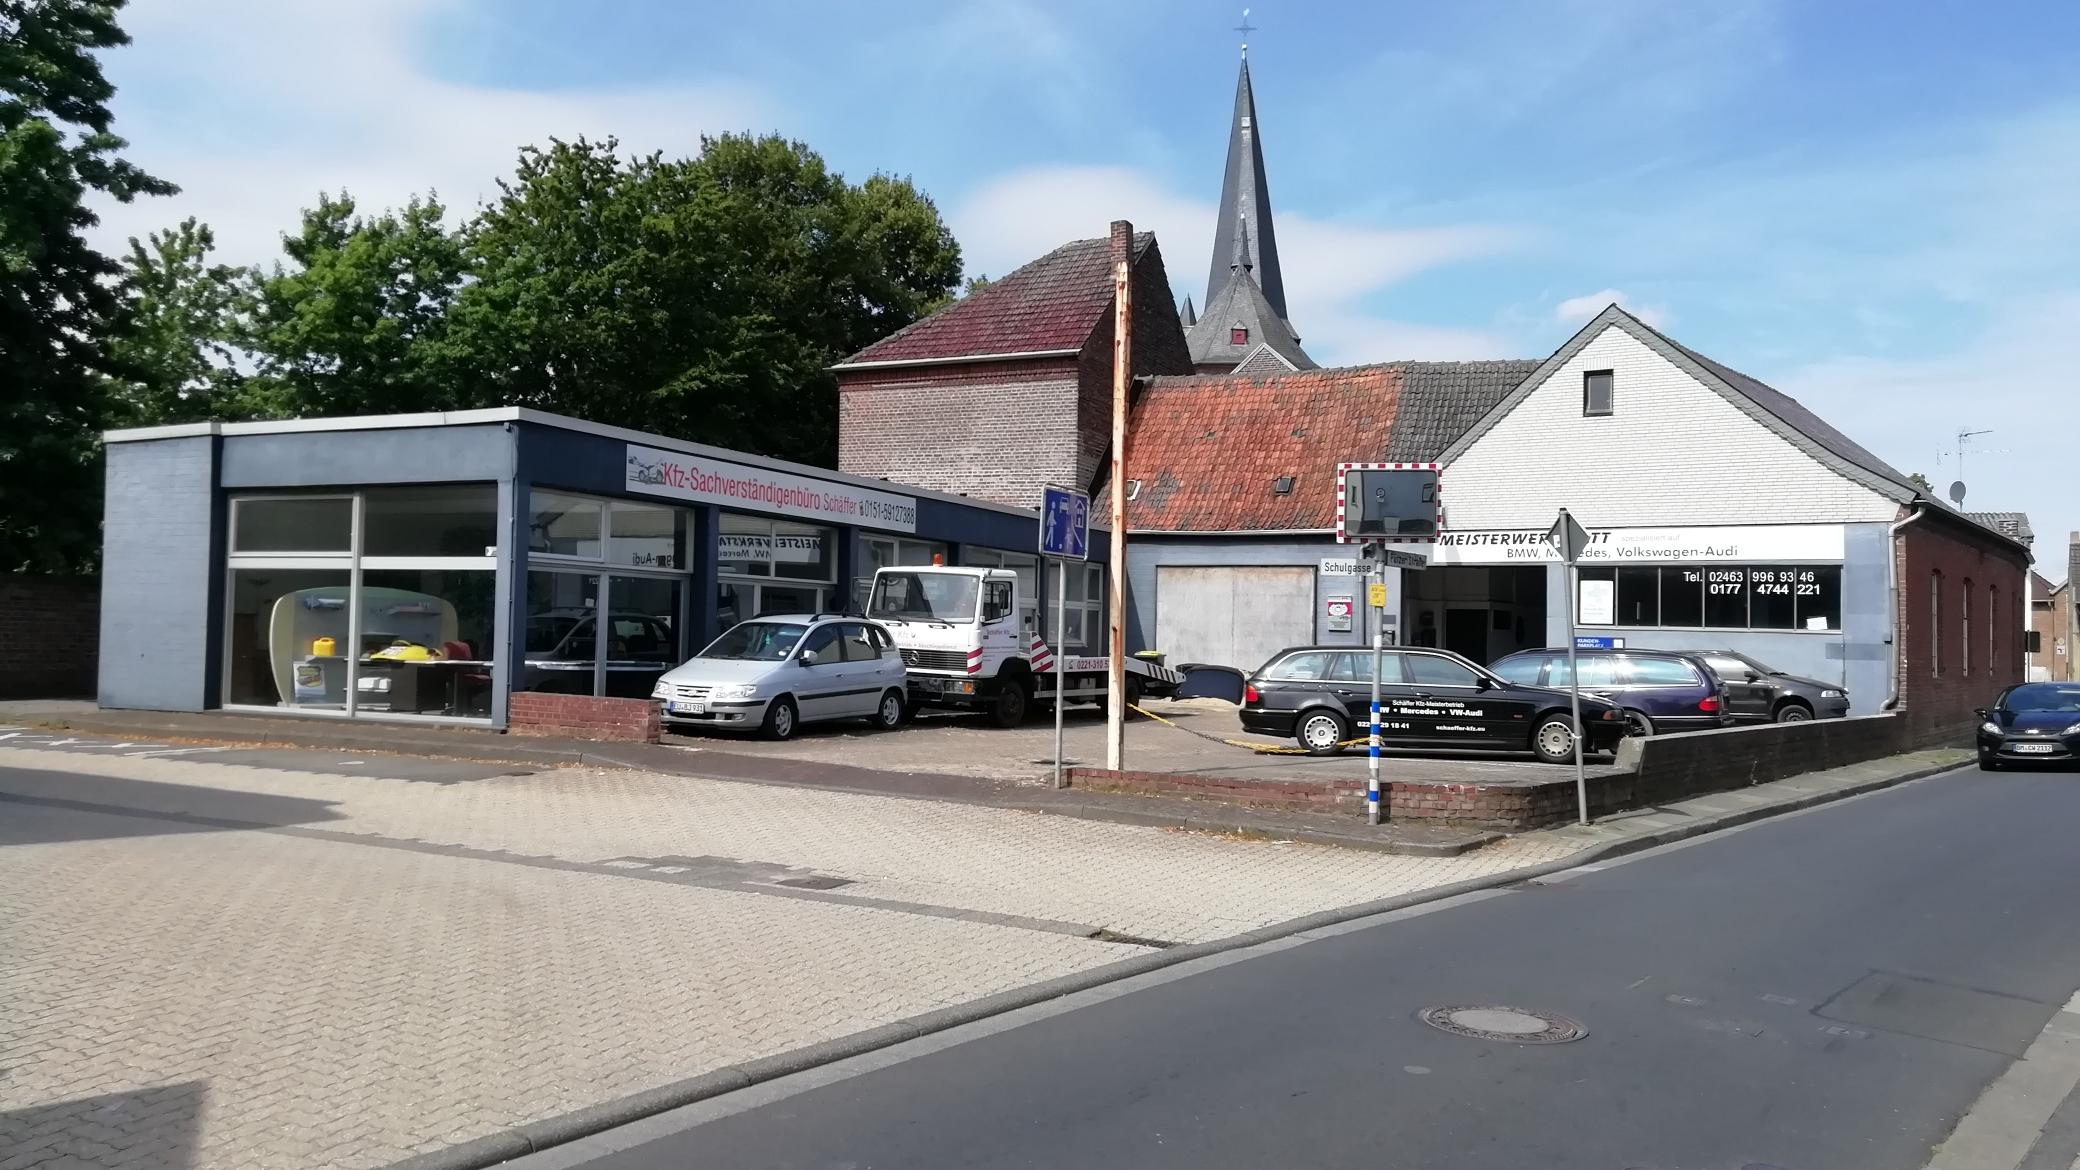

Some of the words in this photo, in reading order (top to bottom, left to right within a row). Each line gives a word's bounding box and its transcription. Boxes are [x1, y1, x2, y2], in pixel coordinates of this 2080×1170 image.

[664, 463, 820, 510] Kfz-Sachverständigenbüro
[823, 493, 857, 515] Schäffer
[1508, 549, 1541, 559] BMW,
[1616, 545, 1738, 559] Volkswagen-Audi
[1325, 562, 1371, 574] Schulgasse
[1683, 572, 1703, 582] Tel.
[1709, 572, 1743, 582] 02463
[1752, 572, 1774, 582] 996
[1780, 572, 1794, 582] 93
[1800, 572, 1814, 582] 46
[1710, 584, 1741, 594] 0177
[1757, 584, 1789, 594] 4744
[1797, 584, 1820, 595] 221
[1400, 708, 1439, 716] Mercedes
[1450, 709, 1483, 717] VW-Audi
